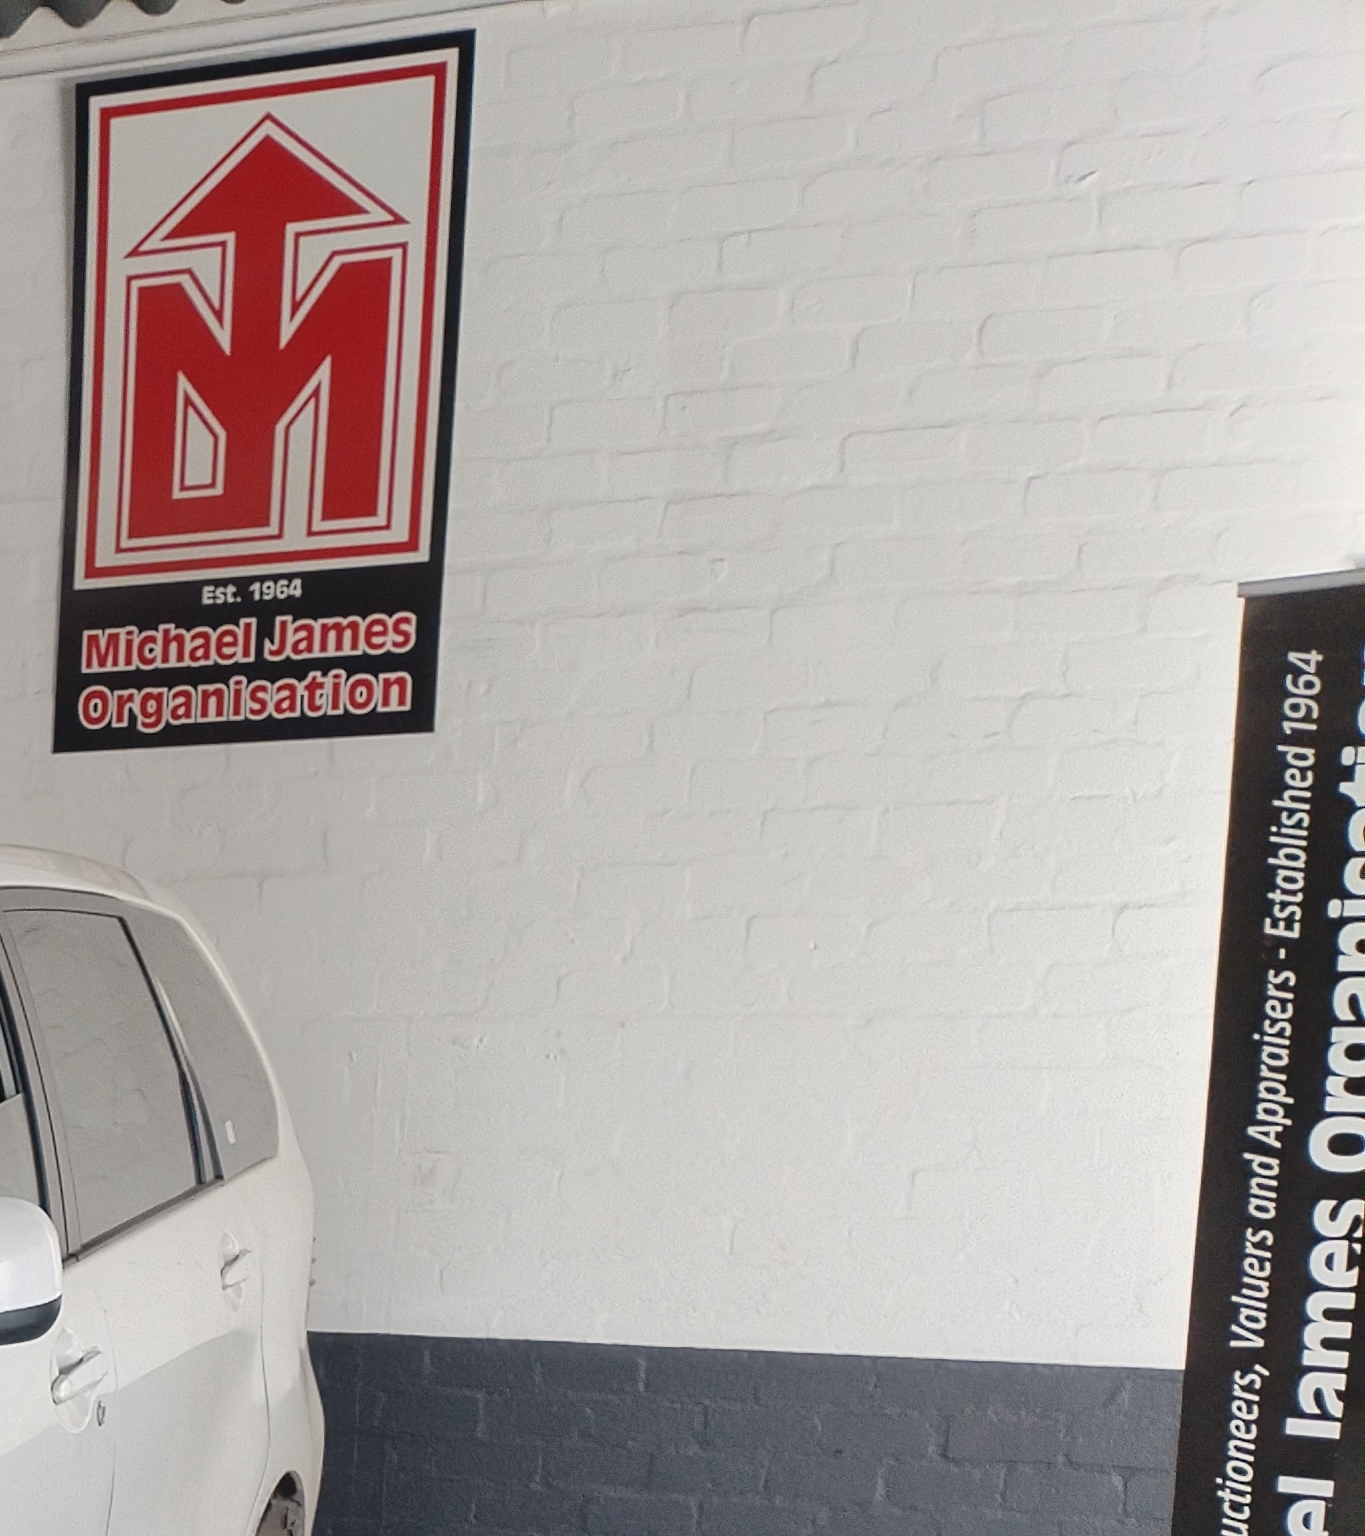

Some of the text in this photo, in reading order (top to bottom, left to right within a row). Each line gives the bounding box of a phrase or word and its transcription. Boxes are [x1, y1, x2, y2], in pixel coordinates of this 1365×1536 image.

[201, 578, 303, 606] Est. 1964
[81, 611, 416, 674] Michael James
[78, 668, 411, 732] Organisation
[1282, 649, 1324, 735] 1964
[1263, 745, 1317, 940] Established
[1246, 969, 1296, 1148] Appraisers
[1243, 1152, 1281, 1220] and
[1229, 1226, 1274, 1349] Valuers
